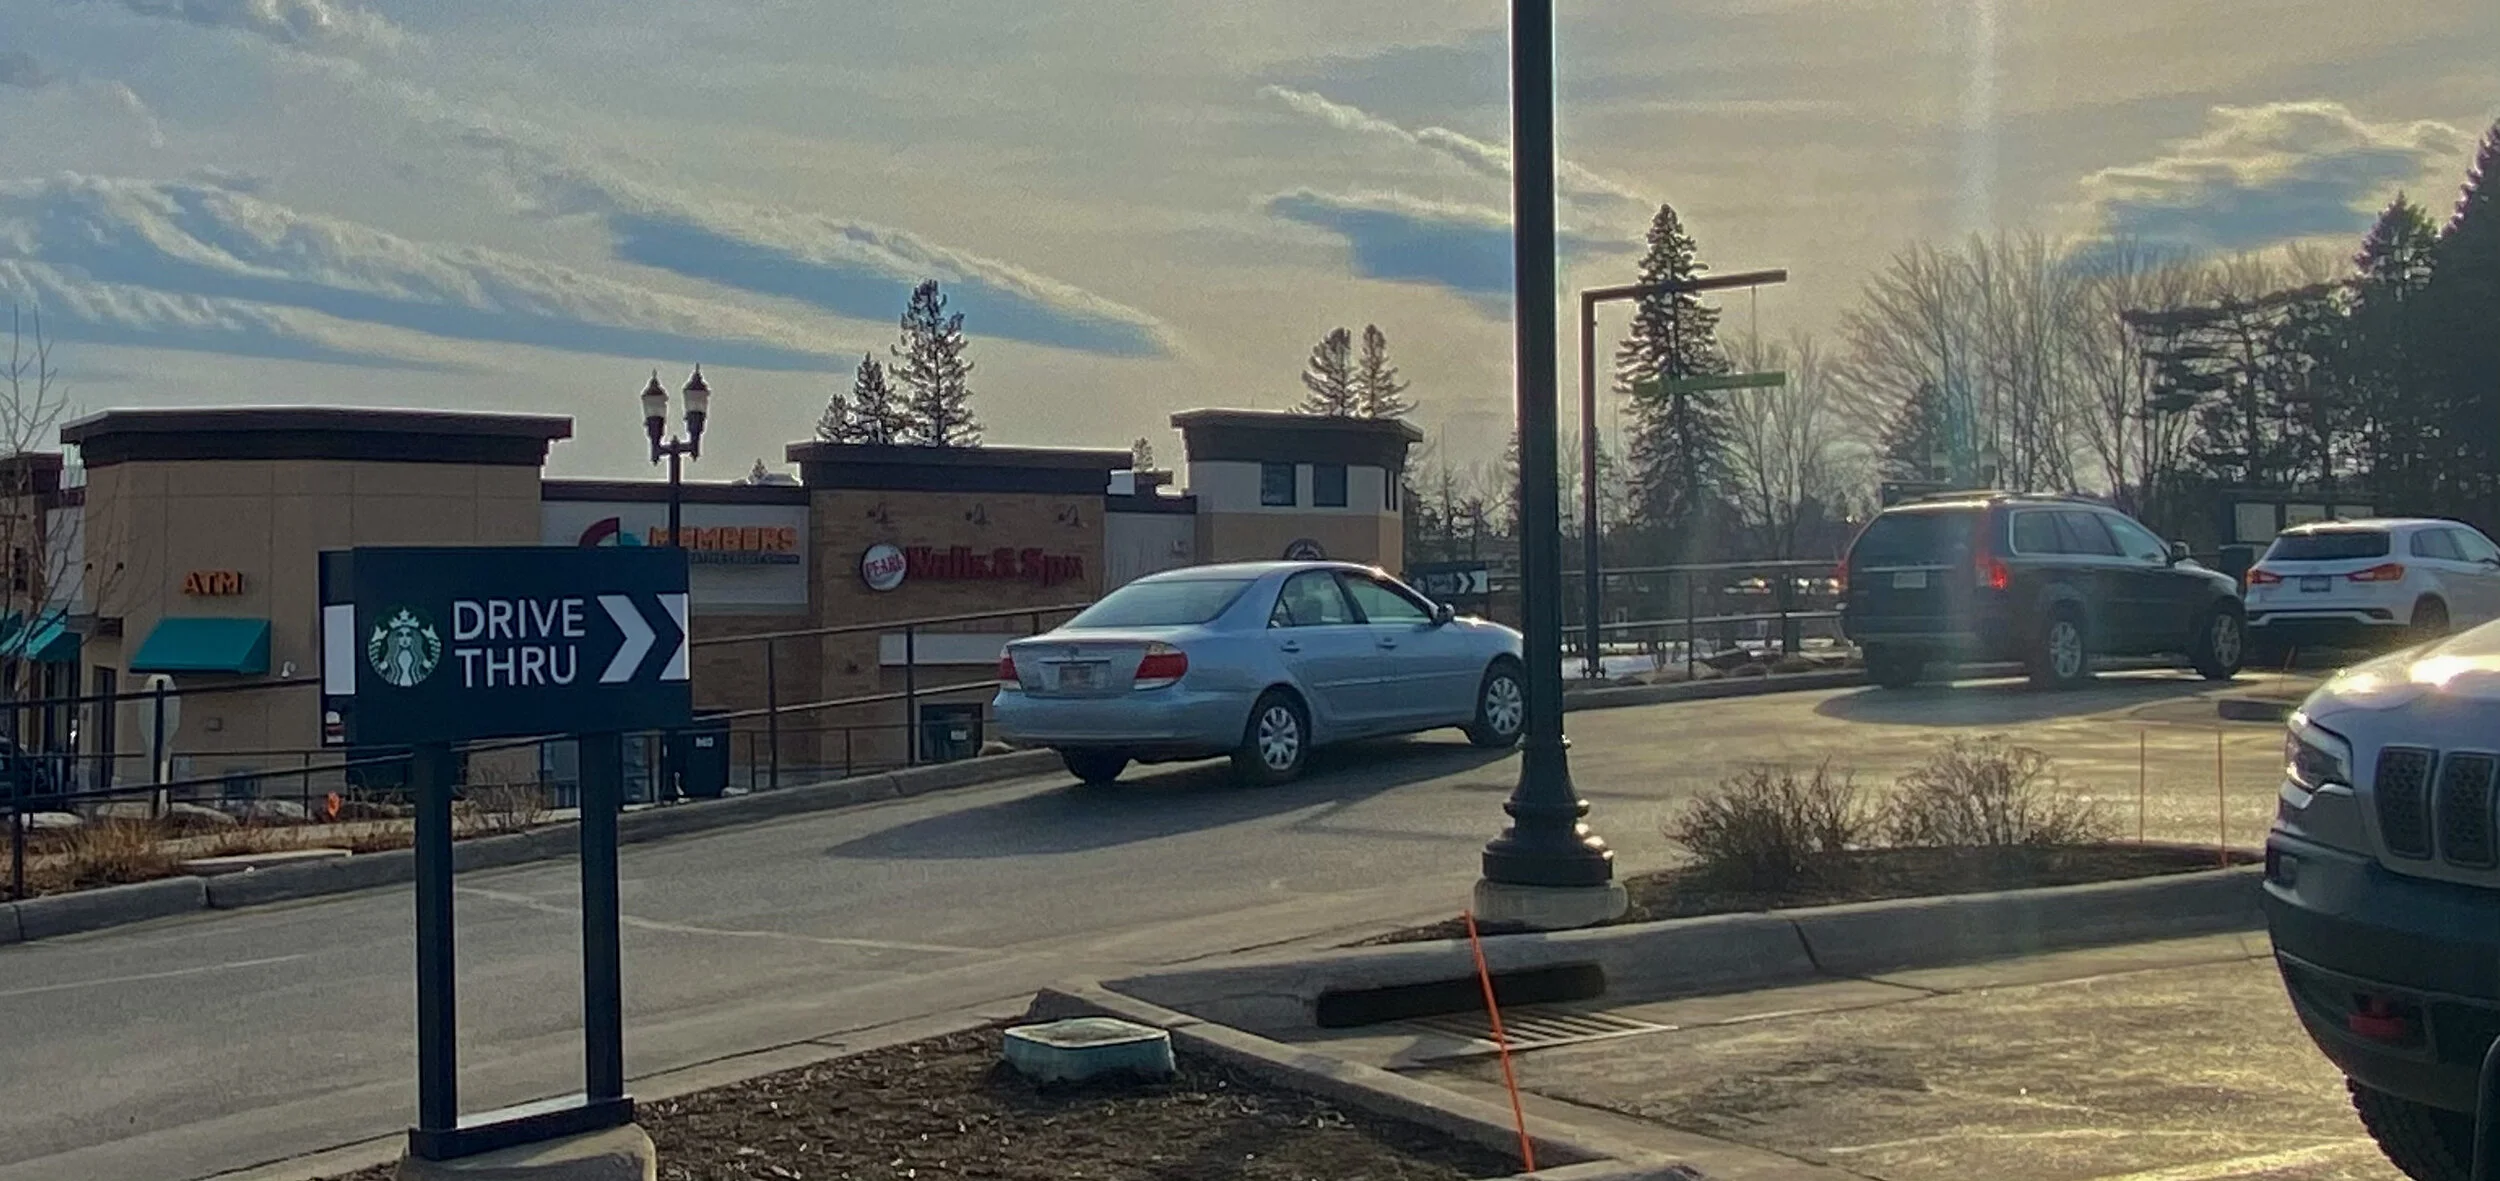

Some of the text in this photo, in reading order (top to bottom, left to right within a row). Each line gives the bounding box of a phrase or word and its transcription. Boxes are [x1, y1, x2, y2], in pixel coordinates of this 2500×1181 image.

[184, 570, 243, 595] ATM
[1020, 547, 1085, 588] Spa
[453, 599, 586, 640] DRIVE
[454, 645, 577, 688] THRU
